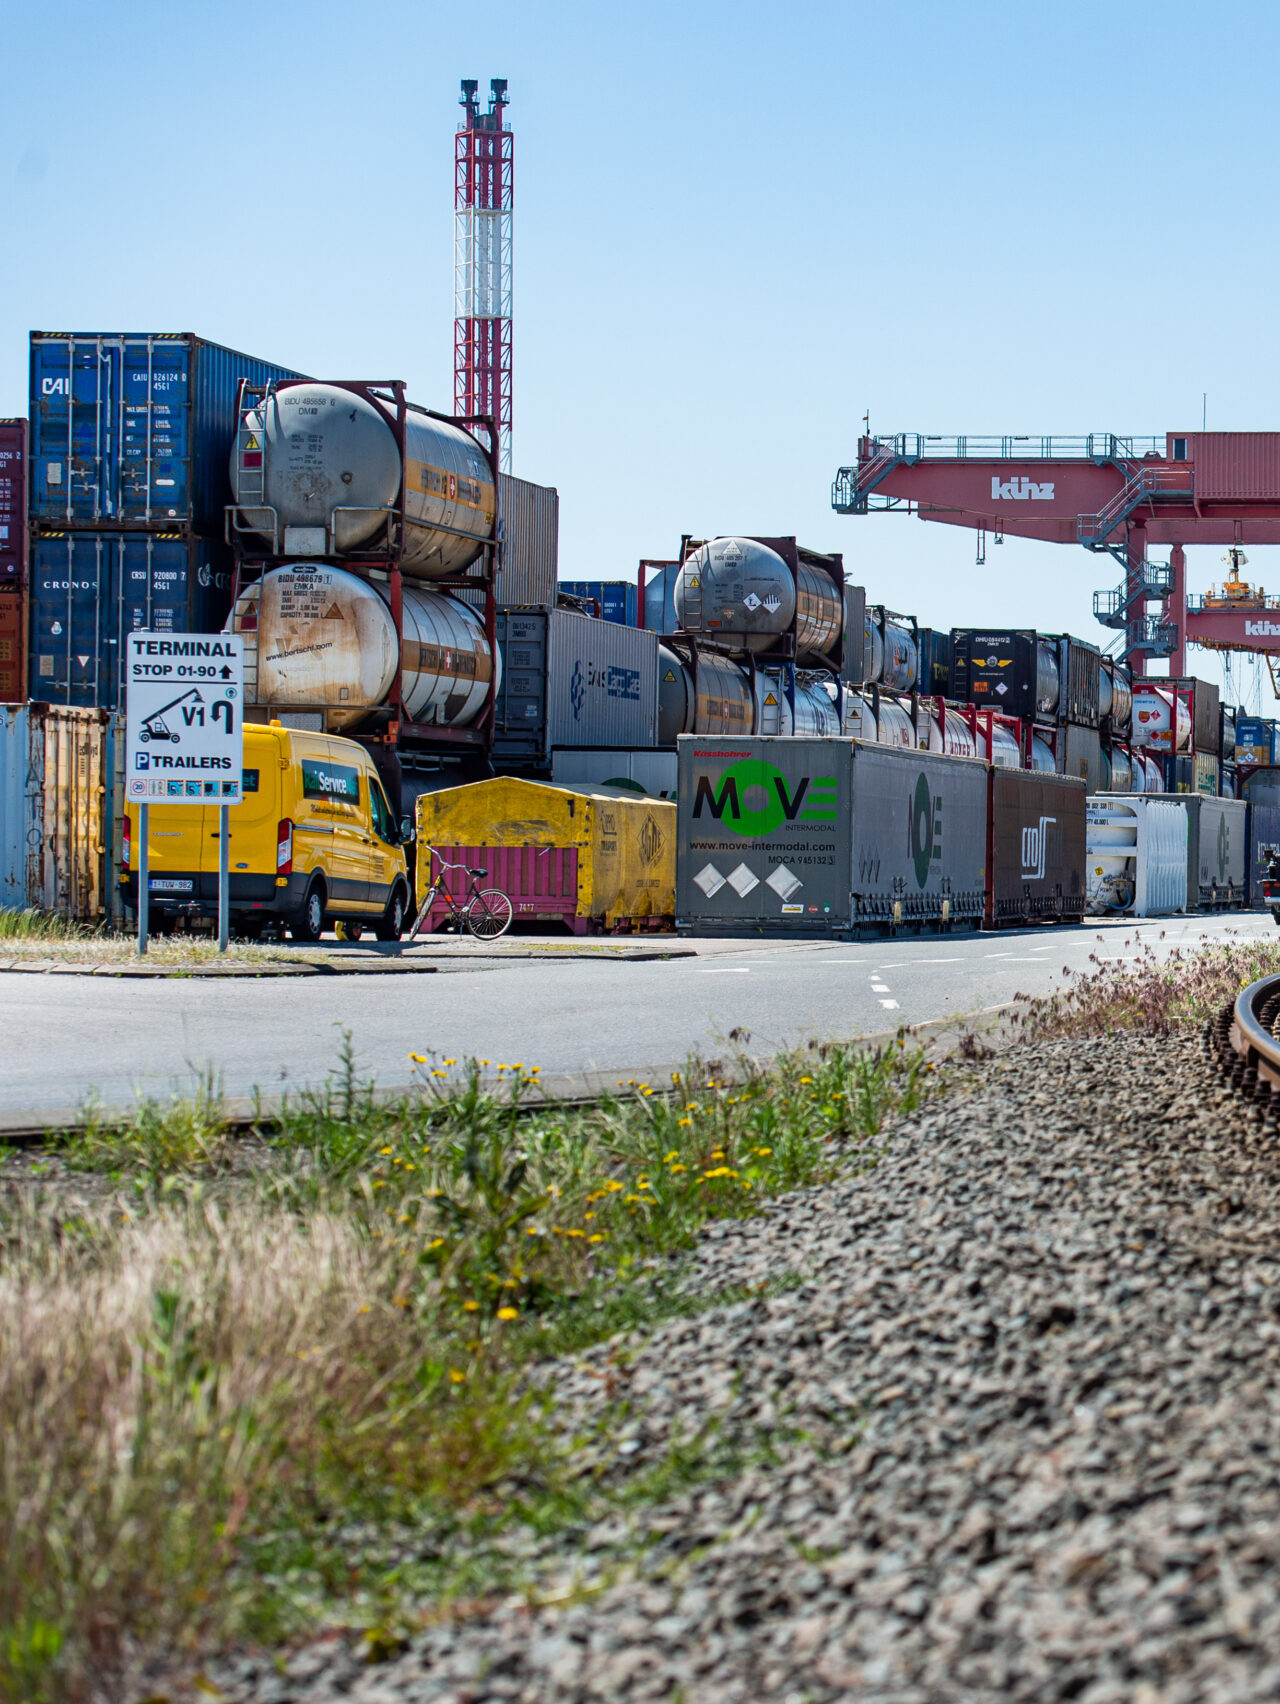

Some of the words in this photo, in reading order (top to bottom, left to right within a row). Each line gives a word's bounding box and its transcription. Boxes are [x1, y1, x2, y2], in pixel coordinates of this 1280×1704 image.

[133, 373, 148, 382] CAIU
[153, 373, 178, 382] 826124
[42, 377, 70, 395] CAI
[991, 476, 1055, 499] künz
[154, 572, 178, 580] 920800
[43, 581, 98, 590] CRONOS
[133, 640, 237, 657] TERMINAL
[133, 664, 173, 676] STOP
[177, 665, 217, 677] 01-90
[182, 706, 205, 727] V1
[152, 756, 232, 769] TRAILERS
[692, 759, 838, 837] MOVE
[785, 824, 836, 832] INTERMODAL
[689, 841, 836, 852] www.move-intermodal.com
[768, 856, 796, 865] MOCA
[797, 856, 827, 865] 945132
[153, 880, 192, 889] 1-TUW-982
